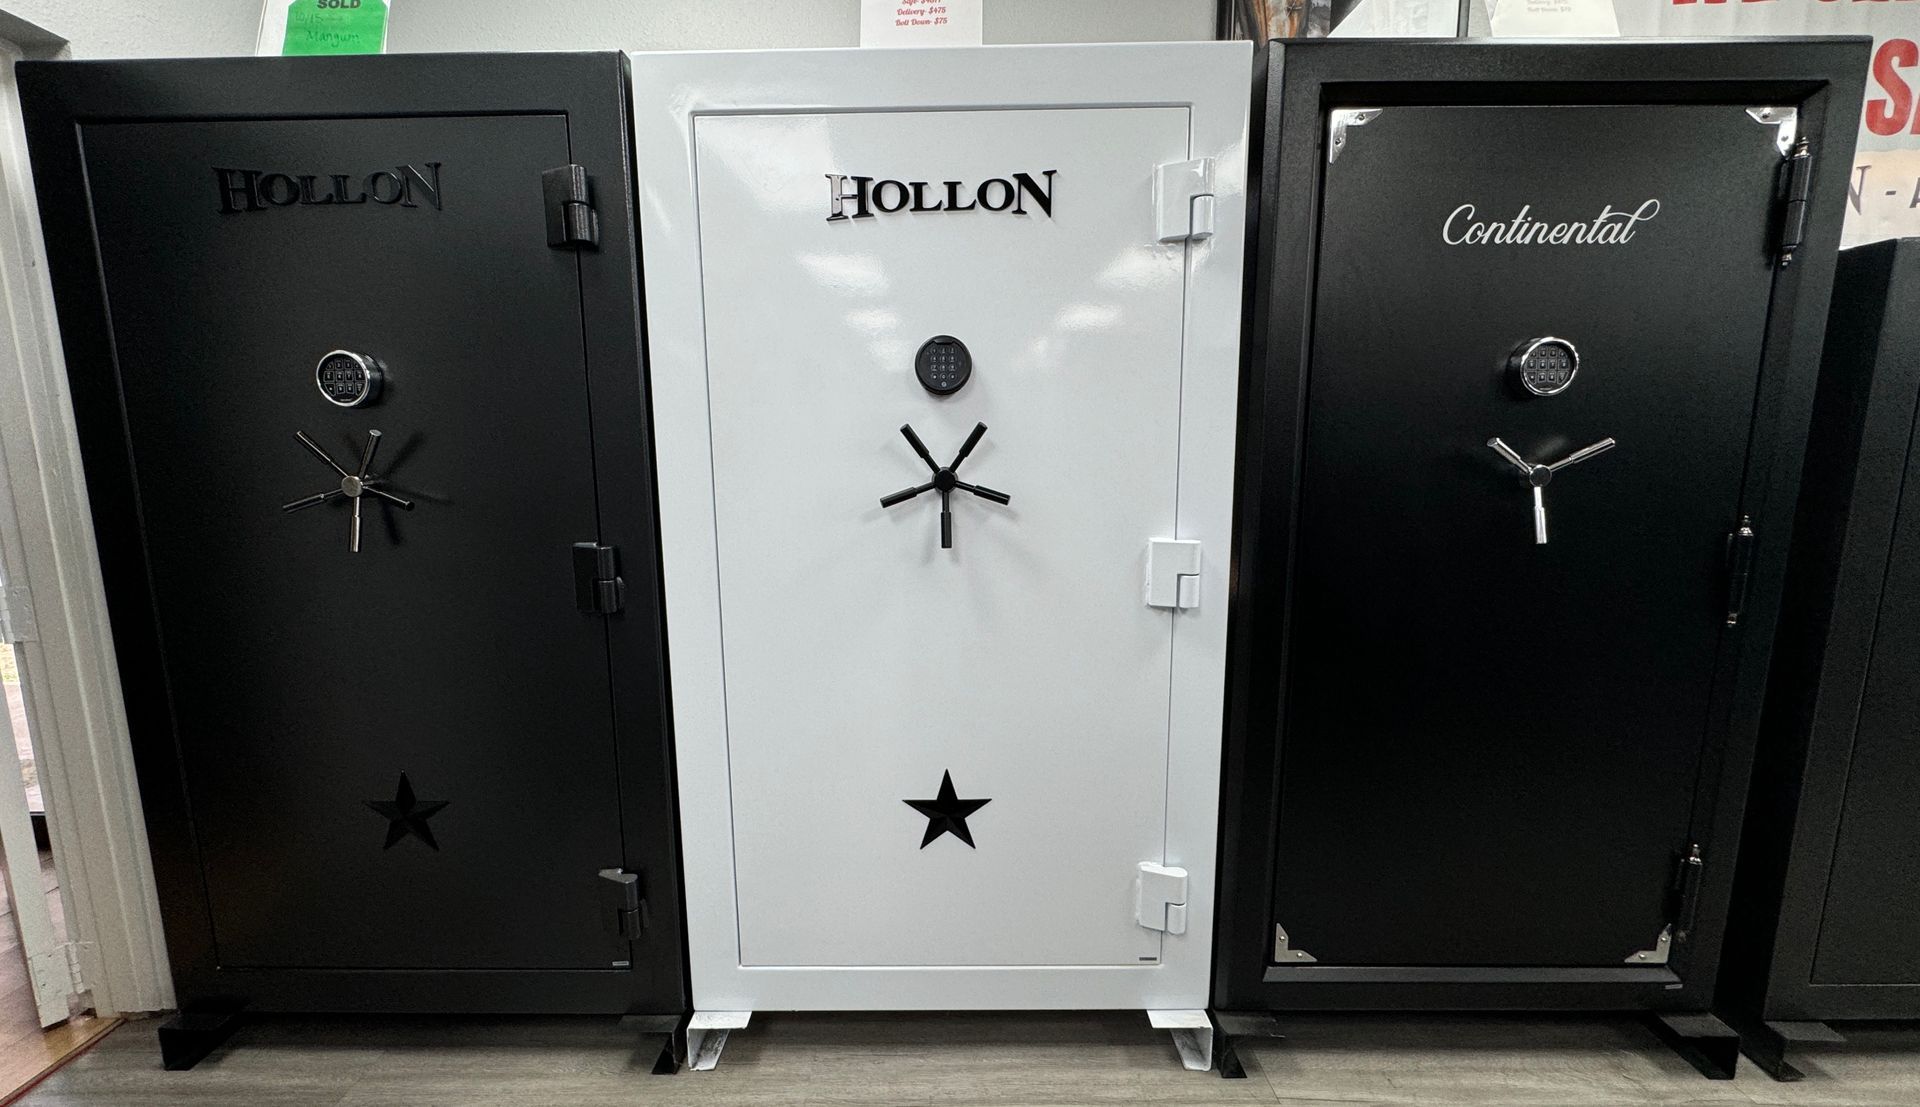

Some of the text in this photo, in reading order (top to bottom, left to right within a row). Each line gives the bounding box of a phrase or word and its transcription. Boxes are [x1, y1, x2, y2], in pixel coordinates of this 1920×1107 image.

[316, 0, 361, 9] SOLD
[211, 161, 443, 213] HOLLON
[825, 169, 1057, 222] HOLLON
[1442, 198, 1661, 246] Continental
